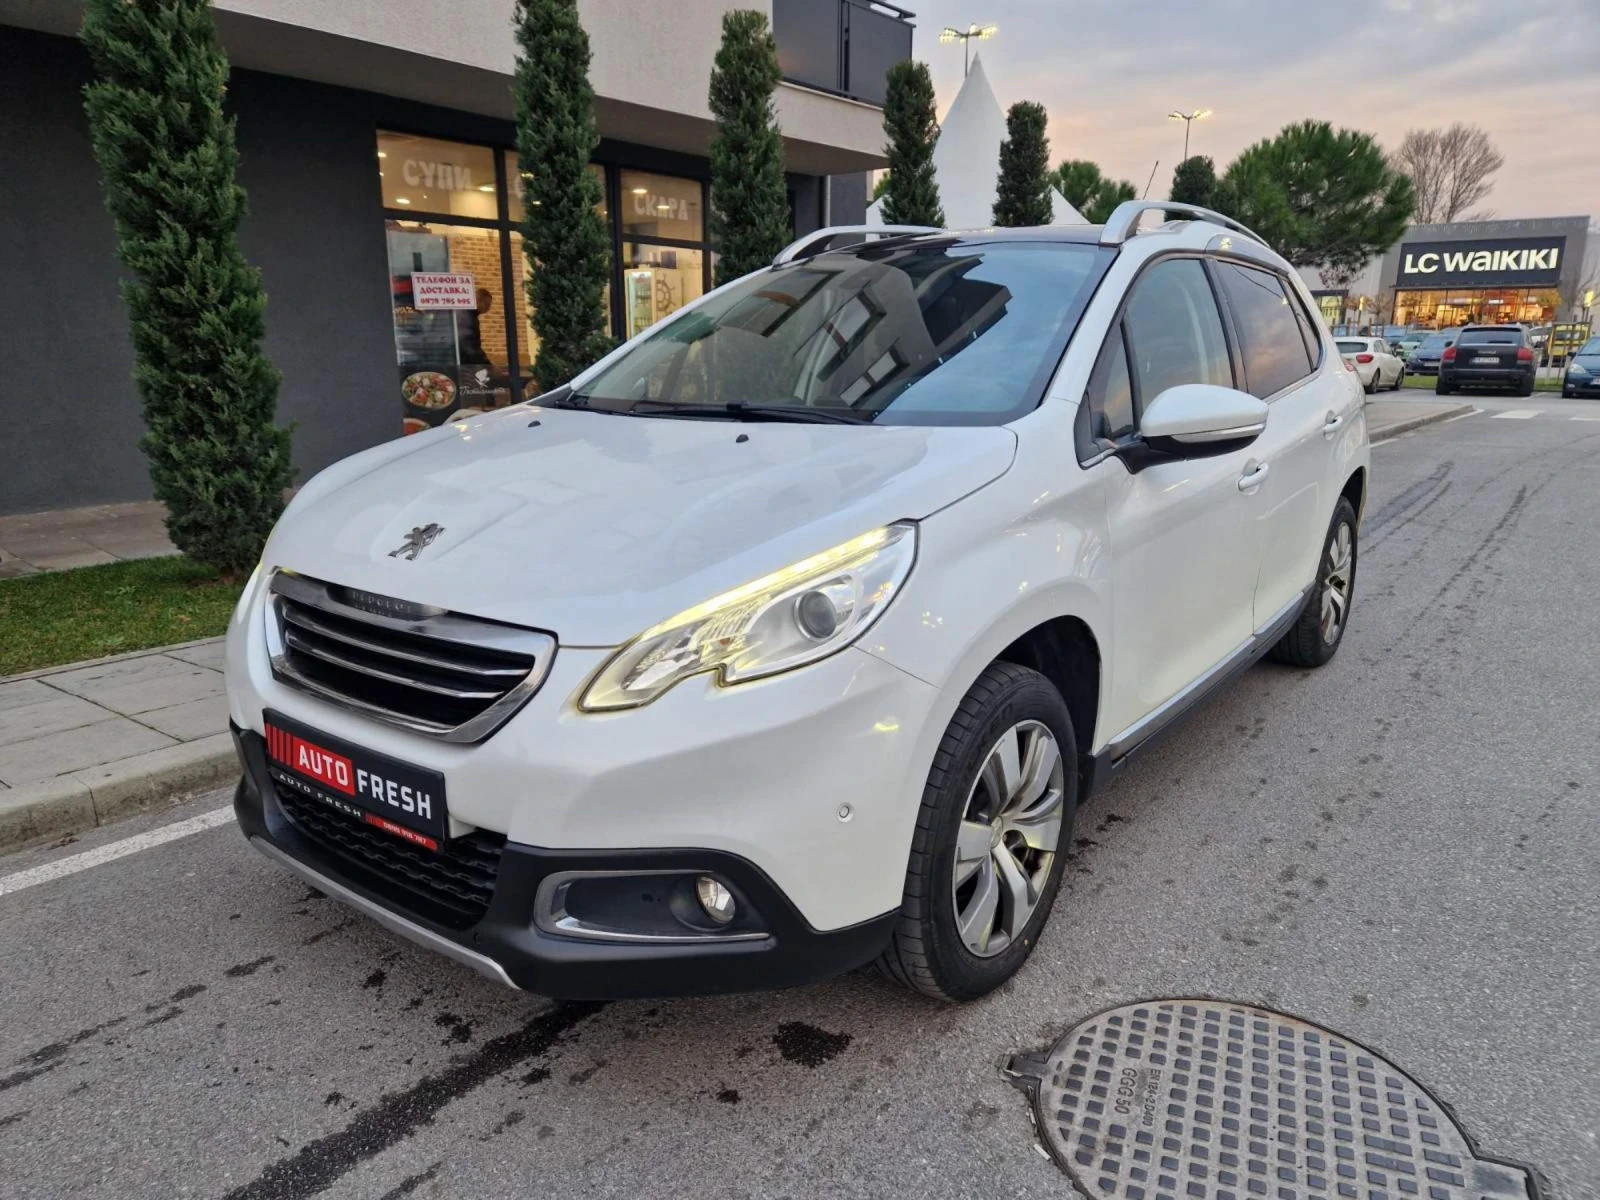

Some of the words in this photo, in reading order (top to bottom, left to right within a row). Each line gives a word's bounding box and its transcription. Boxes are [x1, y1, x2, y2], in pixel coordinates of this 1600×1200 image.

[403, 159, 472, 191] СУПИ
[634, 194, 689, 221] СКАРА
[1404, 252, 1440, 274] LC
[416, 276, 457, 284] ТЕЛЕФОН
[459, 276, 471, 284] ЗА
[279, 773, 312, 793] AUTO
[317, 792, 362, 818] FRESH
[298, 745, 348, 787] AUTO
[356, 768, 432, 820] FRESH
[1118, 1068, 1137, 1097] GGG
[1150, 1069, 1161, 1081] EN
[1115, 1098, 1130, 1114] 50
